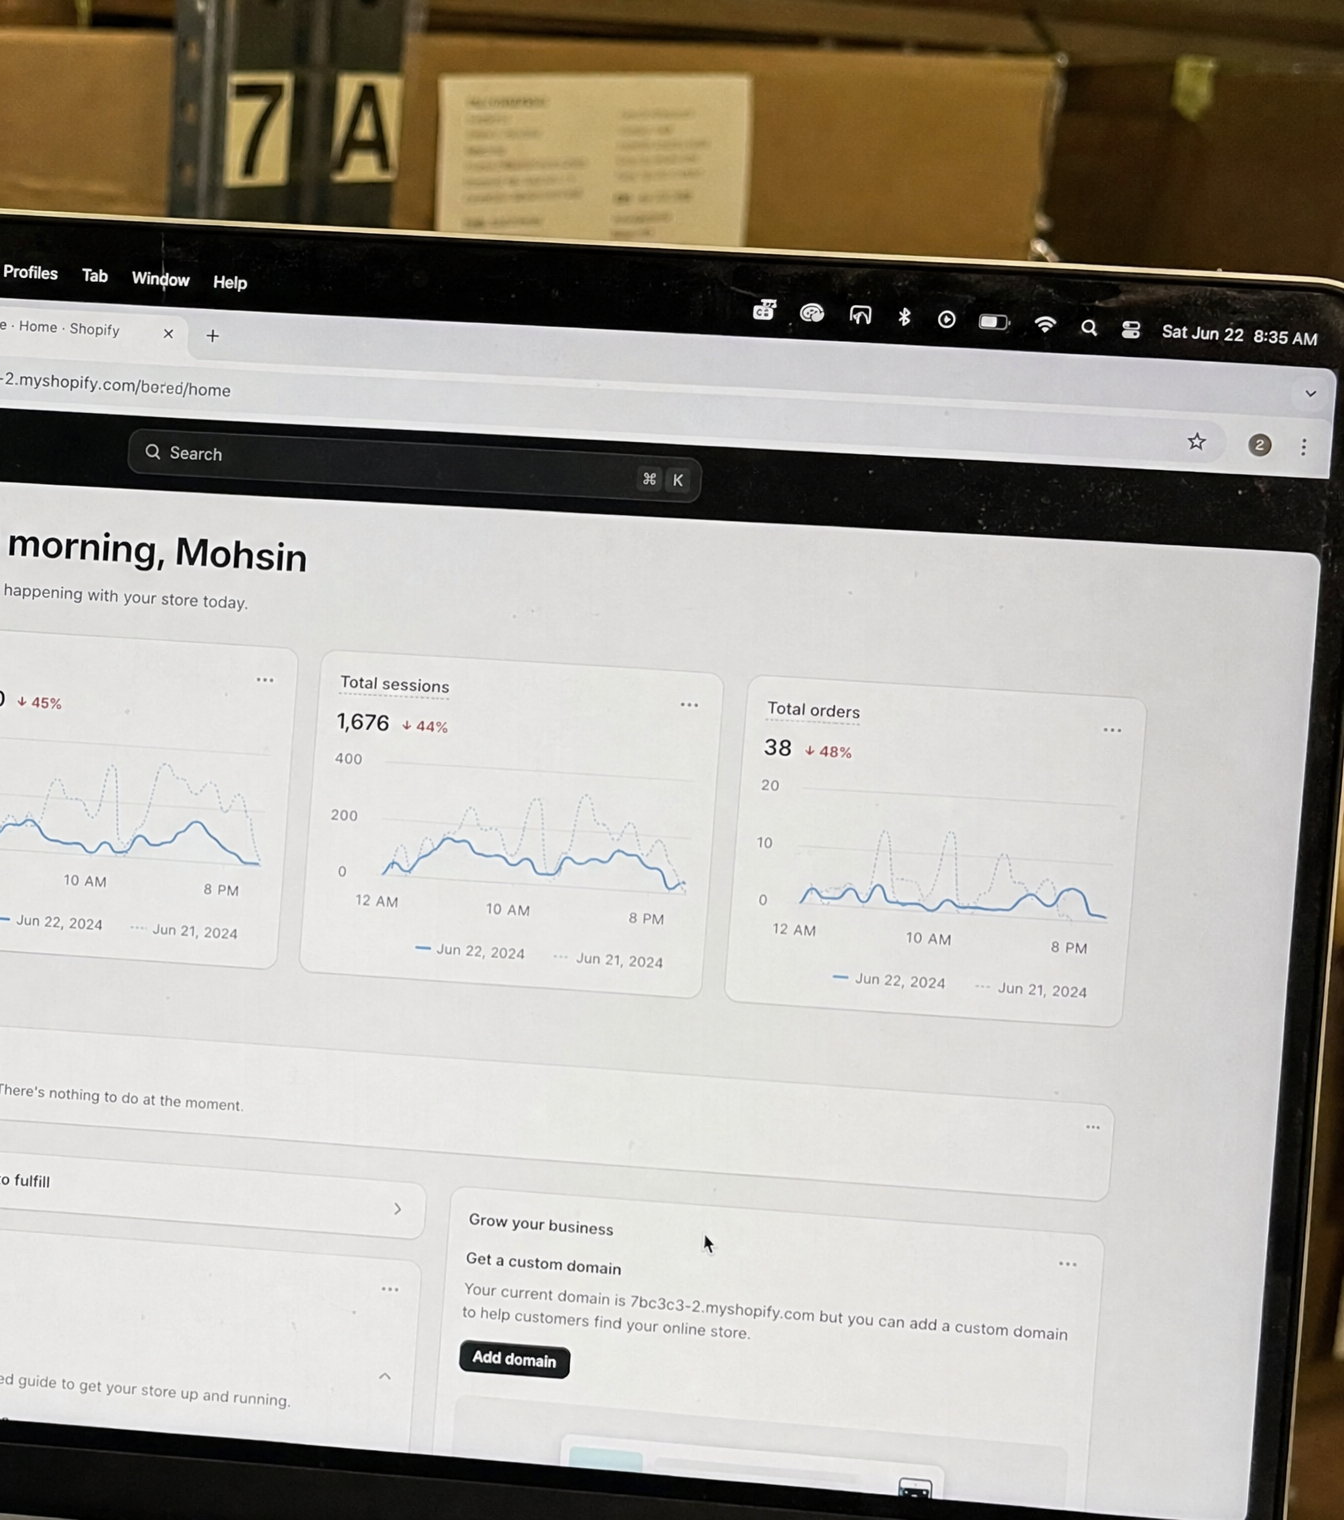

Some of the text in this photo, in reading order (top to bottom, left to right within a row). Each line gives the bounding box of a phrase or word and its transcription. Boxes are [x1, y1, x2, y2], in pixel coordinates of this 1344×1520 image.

[231, 83, 284, 177] 7
[335, 83, 391, 173] A
[3, 263, 59, 281] Profiles
[81, 267, 109, 283] Tab
[131, 267, 191, 292] Window
[213, 274, 248, 293] Help
[18, 319, 58, 334] Home
[69, 321, 120, 339] Shopify
[1161, 323, 1318, 347] Sat Jun 22 8:35 AM
[169, 444, 222, 462] Search
[672, 473, 684, 487] K
[8, 531, 165, 572] morning,
[176, 536, 307, 573] Mohsin
[3, 582, 83, 604] happening
[87, 587, 119, 603] with
[123, 592, 157, 607] your
[160, 593, 199, 608] store
[202, 594, 248, 613] today.
[340, 674, 450, 694] Total sessions
[30, 696, 62, 710] 45%
[767, 700, 860, 719] Total orders
[336, 712, 389, 733] 1,676
[415, 719, 448, 734] 44%
[763, 737, 792, 757] 38
[818, 745, 852, 759] 48%
[334, 751, 363, 766] 400
[760, 778, 780, 792] 20
[330, 808, 358, 822] 200
[756, 835, 773, 849] 10
[15, 913, 103, 931] Jun 22, 2024
[151, 923, 238, 940] Jun 21, 2024
[48, 1088, 100, 1105] nothing
[103, 1090, 118, 1103] to
[121, 1091, 139, 1105] do
[142, 1094, 156, 1106] at
[159, 1094, 182, 1108] the
[185, 1098, 244, 1112] moment.
[14, 1173, 50, 1189] fulfill
[468, 1212, 614, 1237] Grow your business
[465, 1251, 622, 1276] Get a custom domain
[463, 1281, 1068, 1342] Your current domain is 7bc3c3-2.myshopify.com but you can add a custom domain
[461, 1305, 751, 1340] to help customers find your online store.
[471, 1349, 557, 1369] Add domain
[17, 1374, 57, 1390] guide
[61, 1377, 75, 1391] to
[78, 1380, 102, 1395] get
[105, 1383, 138, 1397] your
[141, 1384, 177, 1399] store
[180, 1389, 199, 1403] up
[202, 1389, 229, 1403] and
[232, 1392, 291, 1410] running.
